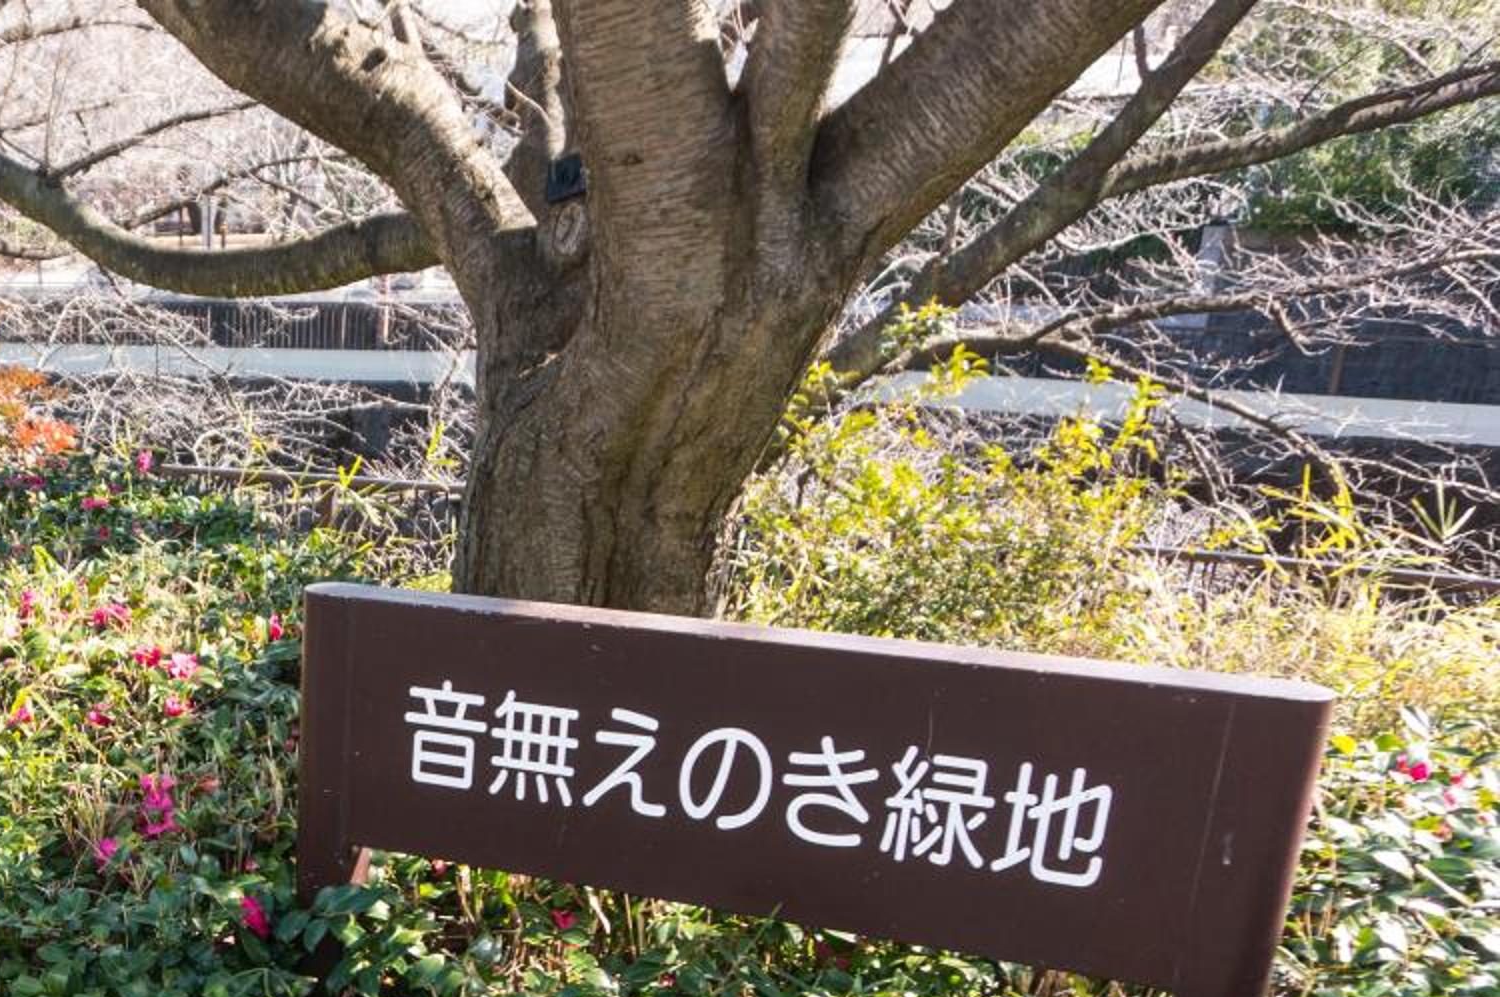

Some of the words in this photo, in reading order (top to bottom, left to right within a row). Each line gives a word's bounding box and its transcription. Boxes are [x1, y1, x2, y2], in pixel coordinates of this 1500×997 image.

[404, 680, 1113, 888] 音無えのき緑地
